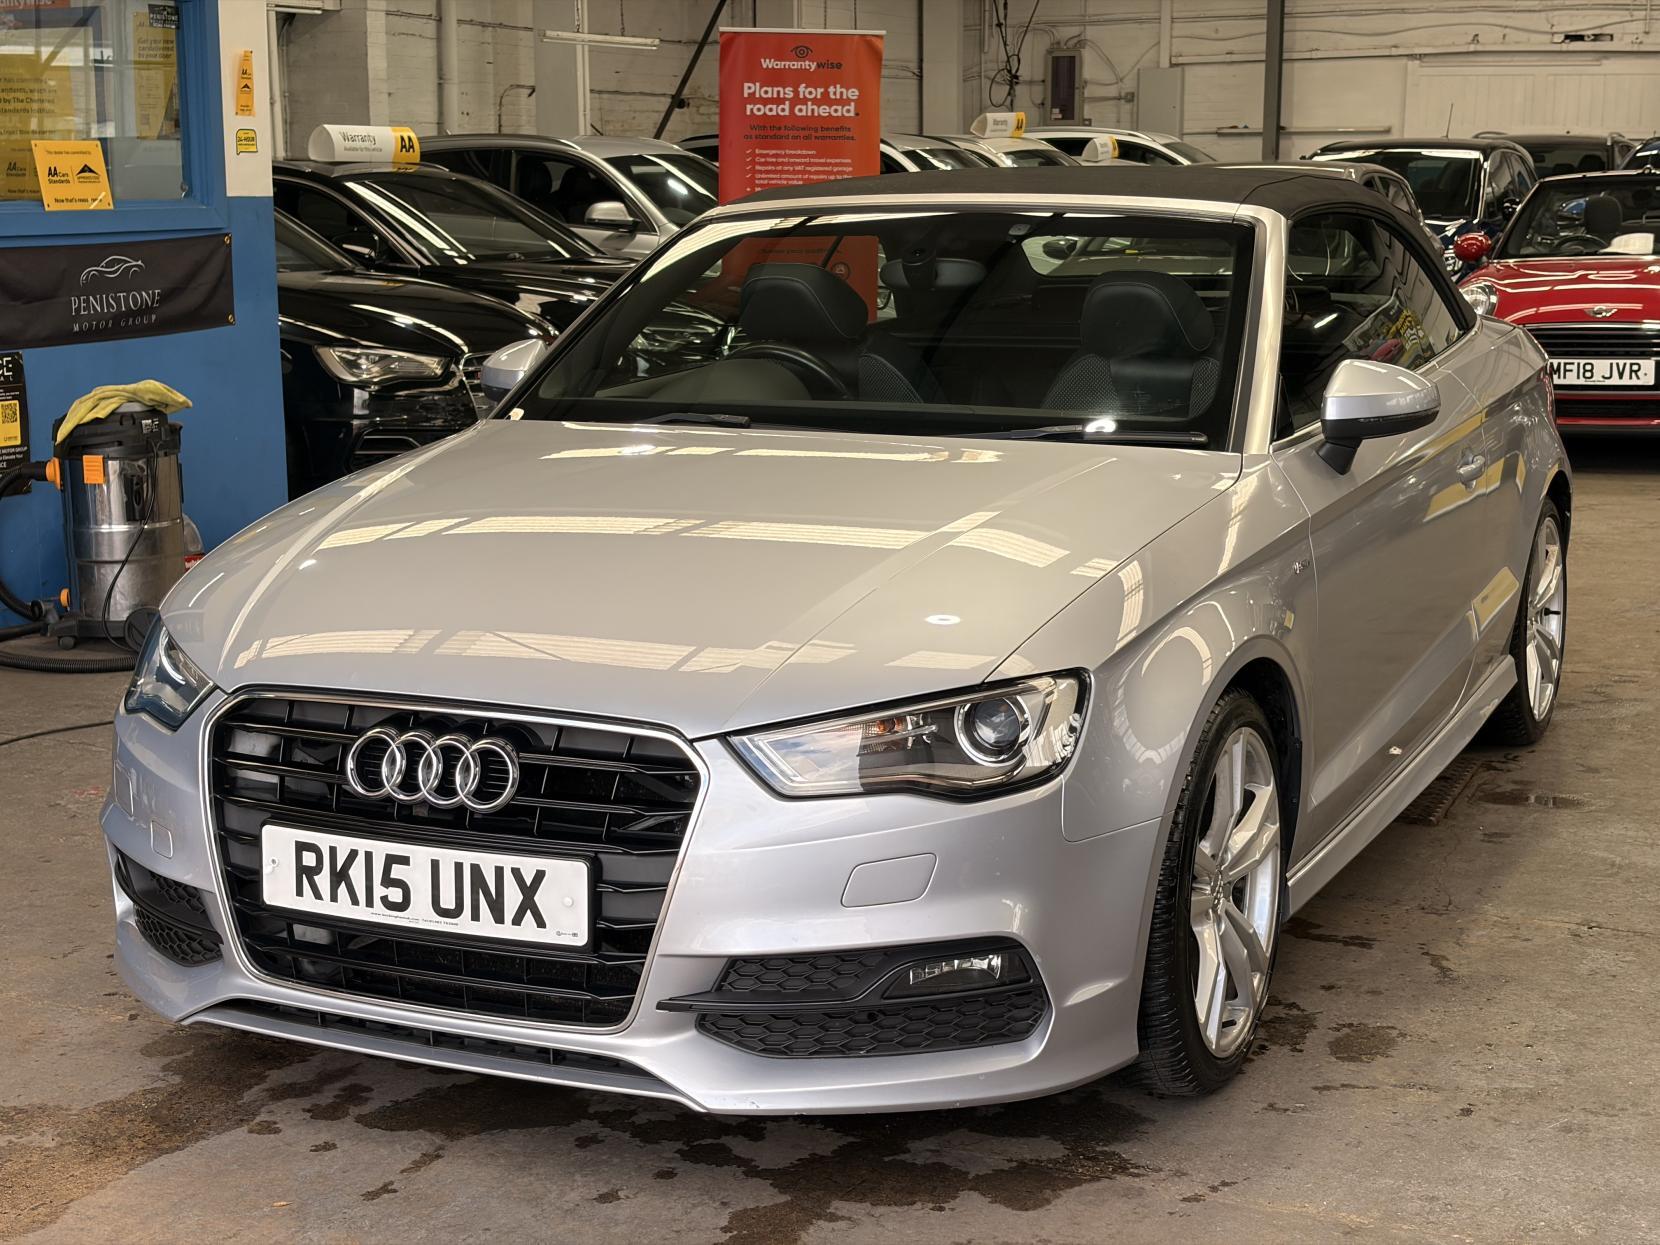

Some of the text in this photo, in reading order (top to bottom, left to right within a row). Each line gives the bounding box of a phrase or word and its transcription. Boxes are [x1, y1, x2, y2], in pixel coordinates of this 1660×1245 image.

[760, 58, 843, 72] Warrantywise
[743, 82, 859, 99] Plans for the
[745, 101, 859, 117] road ahead.
[340, 131, 416, 153] Warranty AA
[47, 166, 59, 178] AA
[71, 289, 162, 316] PENISTONE
[72, 313, 157, 333] MOTOR GROUP
[1548, 361, 1642, 380] MF18 JVR
[294, 840, 548, 929] RK15 UNX
